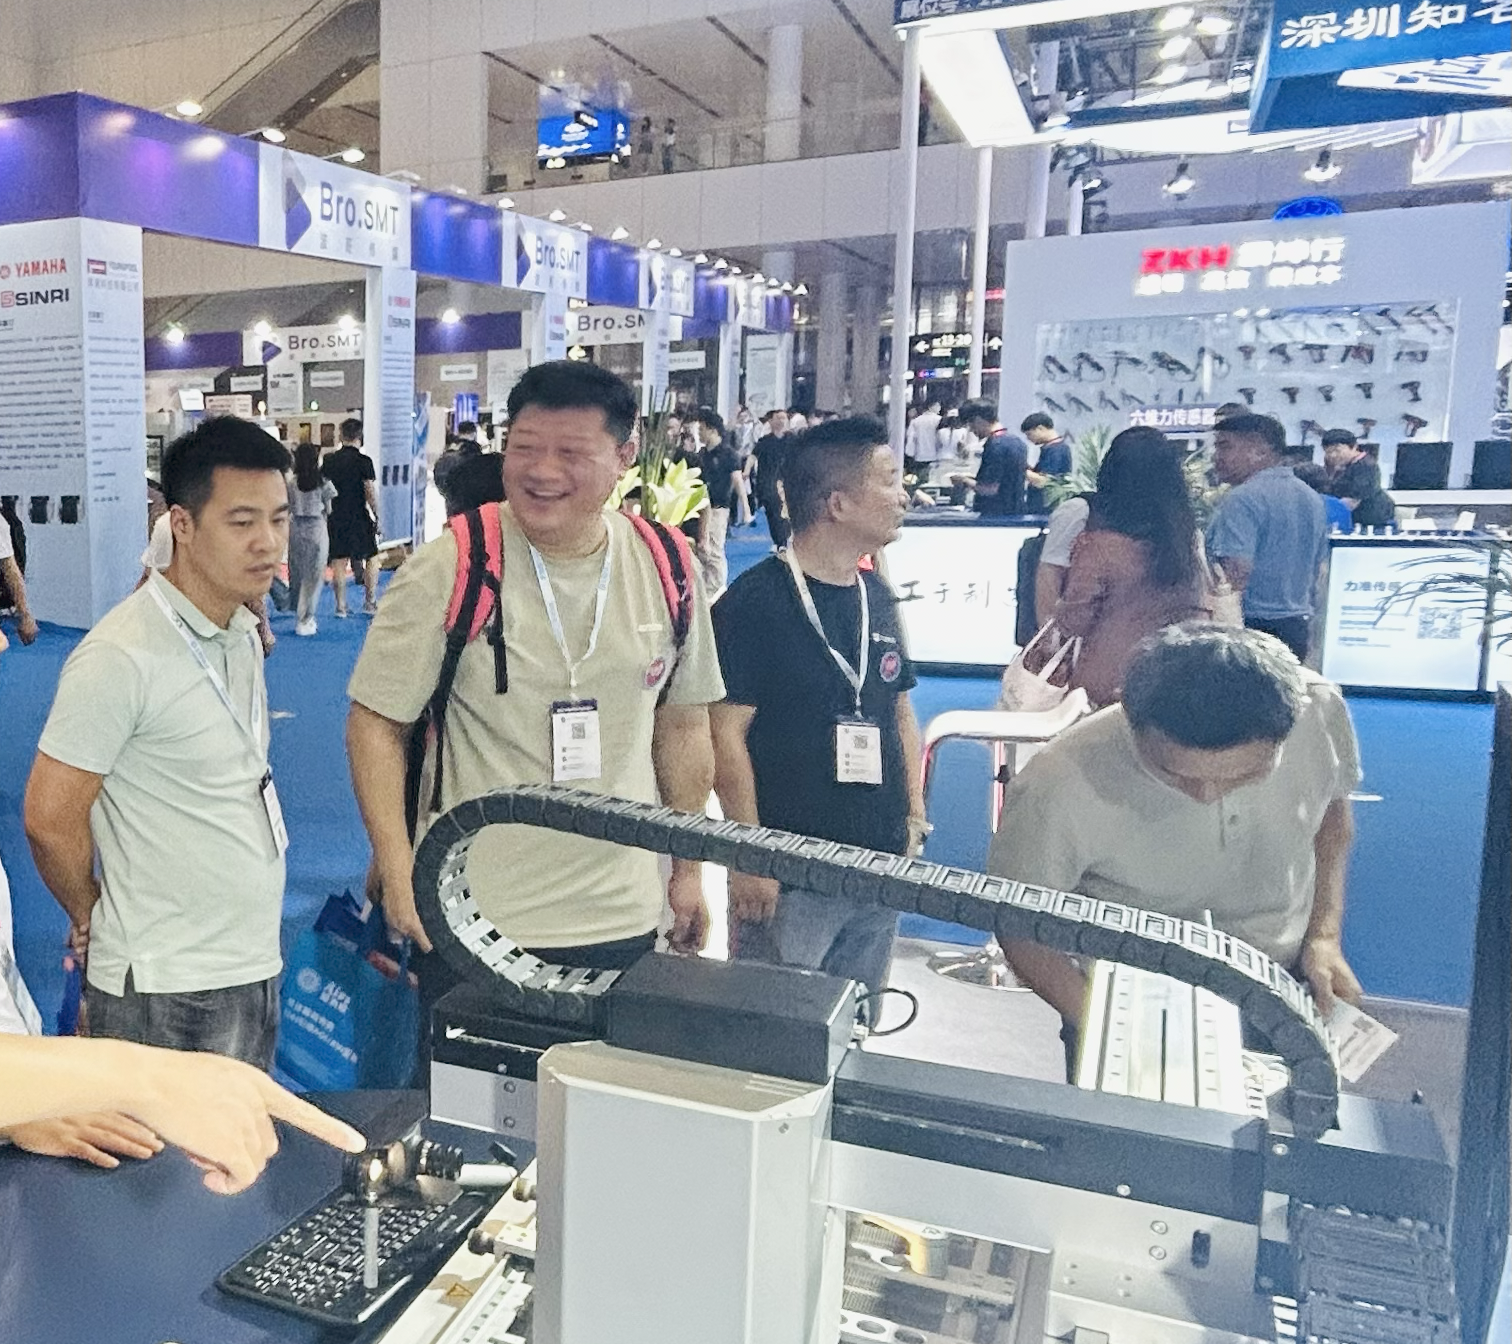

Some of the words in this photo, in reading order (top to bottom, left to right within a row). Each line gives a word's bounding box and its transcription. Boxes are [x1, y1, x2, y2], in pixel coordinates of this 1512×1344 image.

[320, 181, 398, 235] Bro.SMT
[535, 236, 581, 270] Bro.SMT
[1140, 243, 1231, 274] ZKH
[15, 258, 67, 277] YAMAHA
[15, 288, 70, 306] SINRI
[577, 314, 645, 331] Bro.SM
[288, 333, 360, 349] Bro.SMT
